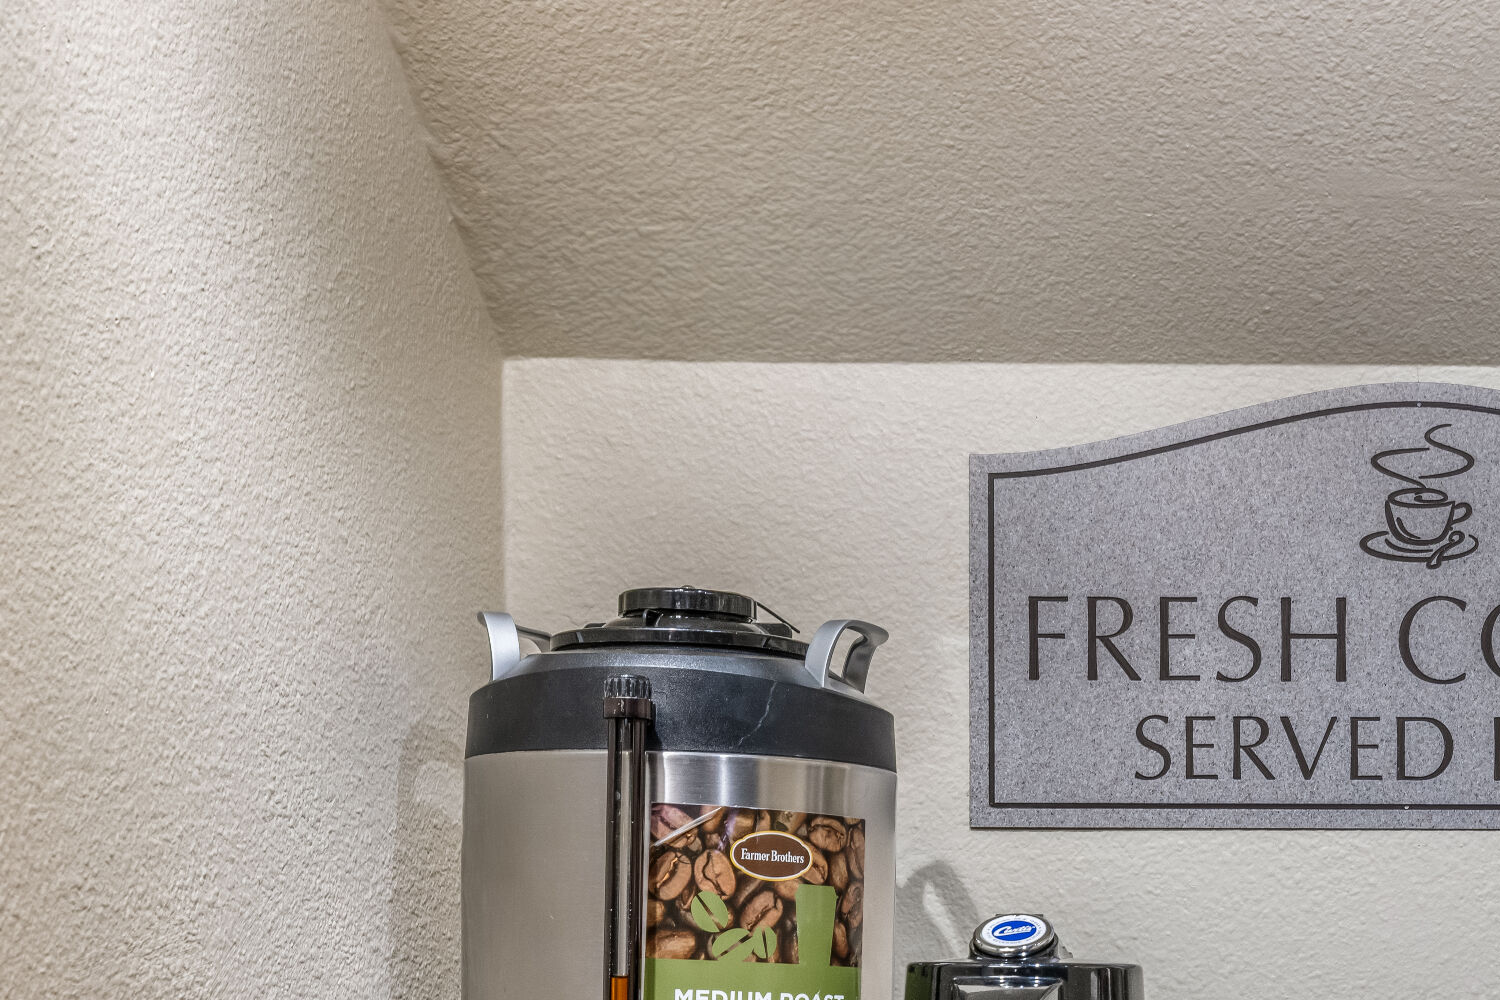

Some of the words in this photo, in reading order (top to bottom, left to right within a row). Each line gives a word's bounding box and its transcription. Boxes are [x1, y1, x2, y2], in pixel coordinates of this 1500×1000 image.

[1027, 594, 1348, 683] FRESH
[1134, 713, 1455, 782] SERVED
[741, 848, 770, 861] Farmer
[771, 850, 804, 864] Brothers
